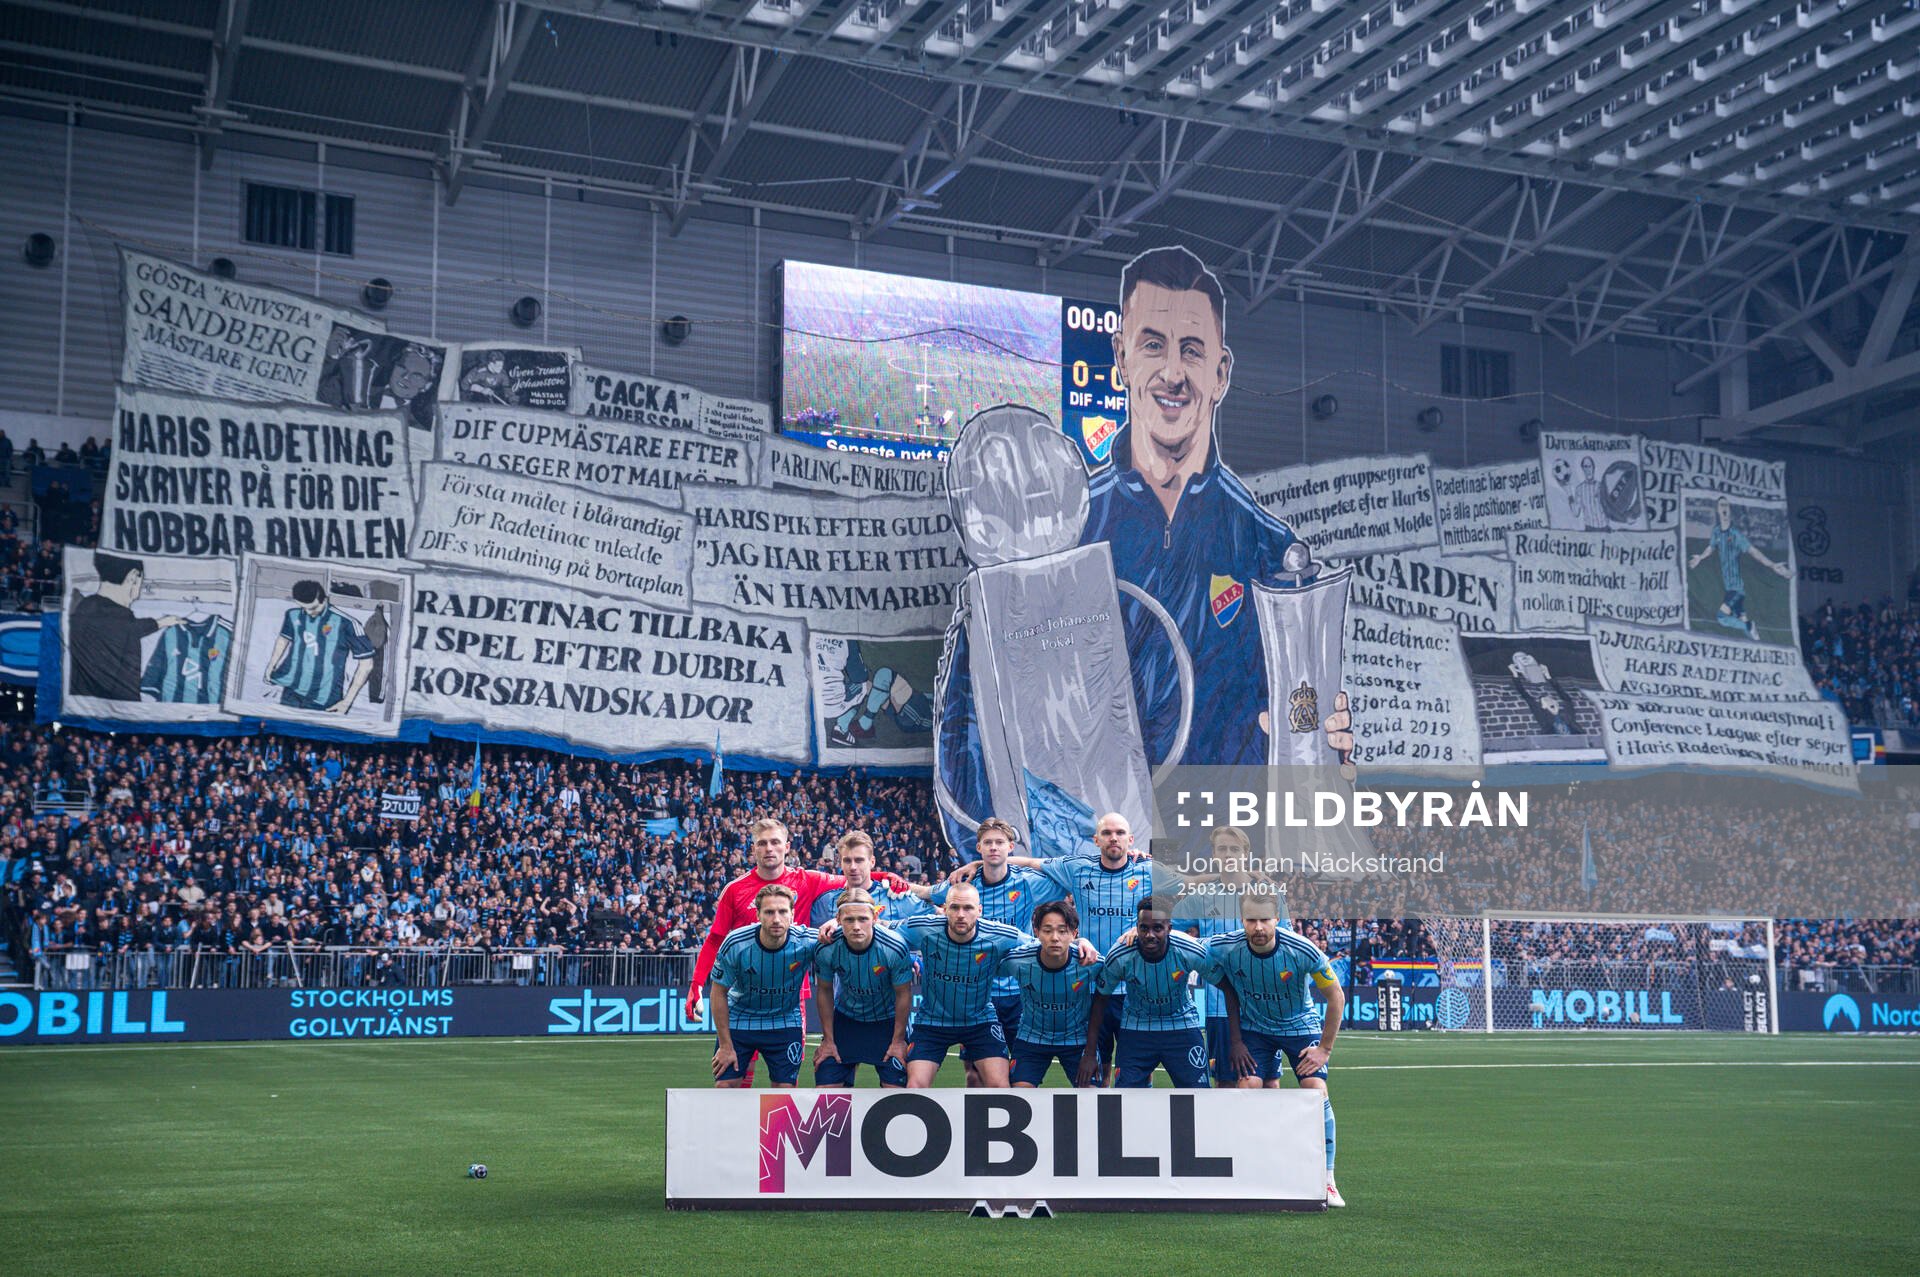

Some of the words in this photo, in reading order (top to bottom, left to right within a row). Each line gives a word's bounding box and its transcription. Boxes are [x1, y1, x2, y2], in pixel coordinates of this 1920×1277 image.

[136, 258, 207, 300] GÖSTA
[134, 289, 317, 364] SANDBERG
[1067, 306, 1122, 334] 00:0
[144, 322, 241, 371] MÄSTARE
[247, 356, 308, 387] IGEN!
[1070, 391, 1093, 407] DIF
[586, 402, 694, 430] ANDERSSON
[119, 408, 211, 458] HARIS
[220, 418, 394, 468] RADETINAC
[453, 419, 497, 440] DIF
[501, 421, 663, 458] CUPMÄSTARE
[665, 439, 739, 469] EFTER
[497, 454, 571, 479] SEGER
[575, 460, 625, 485] MOT
[874, 468, 927, 492] RIKTIG
[929, 466, 946, 496] JÄ
[1489, 472, 1507, 491] har
[1509, 466, 1541, 492] spelat
[1643, 445, 1692, 474] SVEN
[1697, 448, 1783, 490] LINDMAN
[116, 461, 232, 506] SKRIVER
[240, 463, 275, 508] PÅ
[284, 468, 334, 511] FÖR
[1255, 479, 1329, 507] jurgården
[1333, 463, 1426, 494] gruppsegrare
[1359, 492, 1389, 515] efter
[1392, 485, 1431, 507] Haris
[440, 473, 504, 502] Första
[511, 490, 567, 516] målet
[572, 502, 579, 519] i
[583, 503, 683, 544] blårandigt
[696, 508, 770, 533] HARIS
[774, 512, 810, 536] PIK
[815, 516, 887, 538] EFTER
[1440, 501, 1451, 525] på
[1453, 501, 1471, 520] alla
[1473, 497, 1521, 522] positioner
[1529, 494, 1545, 510] var
[114, 507, 255, 555] NOBBAR
[265, 516, 409, 558] RIVALEN
[449, 505, 485, 528] för
[489, 511, 590, 549] Radetinac
[595, 538, 662, 566] inledde
[1368, 521, 1391, 538] mot
[1394, 512, 1433, 534] Molde
[1444, 523, 1490, 545] mittback
[419, 530, 468, 554] DIF:s
[473, 538, 561, 575] vändning
[566, 559, 591, 579] på
[595, 562, 684, 598] bortaplan
[765, 545, 822, 571] HAR
[828, 549, 891, 572] FLER
[895, 546, 968, 571] TITLA
[1515, 534, 1597, 559] Radetinac
[1601, 538, 1675, 566] hoppade
[1518, 566, 1533, 584] in
[1537, 568, 1565, 585] som
[1568, 568, 1627, 589] målvakt
[1640, 570, 1669, 591] höll
[1797, 566, 1844, 584] rena
[733, 573, 774, 605] ÄN
[782, 582, 957, 611] HAMMARBY
[414, 589, 621, 634] RADETINAC
[629, 609, 792, 654] TILLBAKA
[1047, 611, 1110, 632] Johanssons
[1522, 594, 1565, 611] nollan
[1616, 602, 1684, 624] cupseger
[1041, 632, 1074, 651] Pokal
[1352, 618, 1450, 651] Radetinac:
[412, 626, 428, 650] I
[435, 626, 525, 661] SPEL
[532, 638, 642, 673] EFTER
[652, 651, 786, 688] DUBBLA
[1352, 652, 1422, 672] matcher
[1624, 658, 1678, 677] HARIS
[1682, 663, 1783, 687] RADETINAC
[410, 666, 753, 724] KORSBANDSKADOR
[1345, 674, 1422, 692] säsonger
[1350, 694, 1412, 713] gjorda
[1417, 698, 1451, 713] mål
[1410, 719, 1451, 737] 2019
[1611, 716, 1702, 737] Conference
[1706, 723, 1762, 745] League
[1765, 730, 1802, 748] efter
[1806, 737, 1847, 756] seger
[1353, 740, 1406, 762] pguld
[1412, 743, 1453, 761] 2018
[1627, 740, 1674, 756] Haris
[1088, 906, 1133, 918] MOBILL
[290, 989, 454, 1008] STOCKHOLMS
[548, 988, 717, 1033] stadiu
[1378, 986, 1387, 1030] SELECT
[1389, 986, 1401, 1031] SELECT
[1532, 989, 1683, 1023] MOBILL
[1755, 991, 1768, 1033] SELECT
[289, 1008, 454, 1037] GOLVTJÄNST
[759, 1093, 1233, 1194] MOBILL
